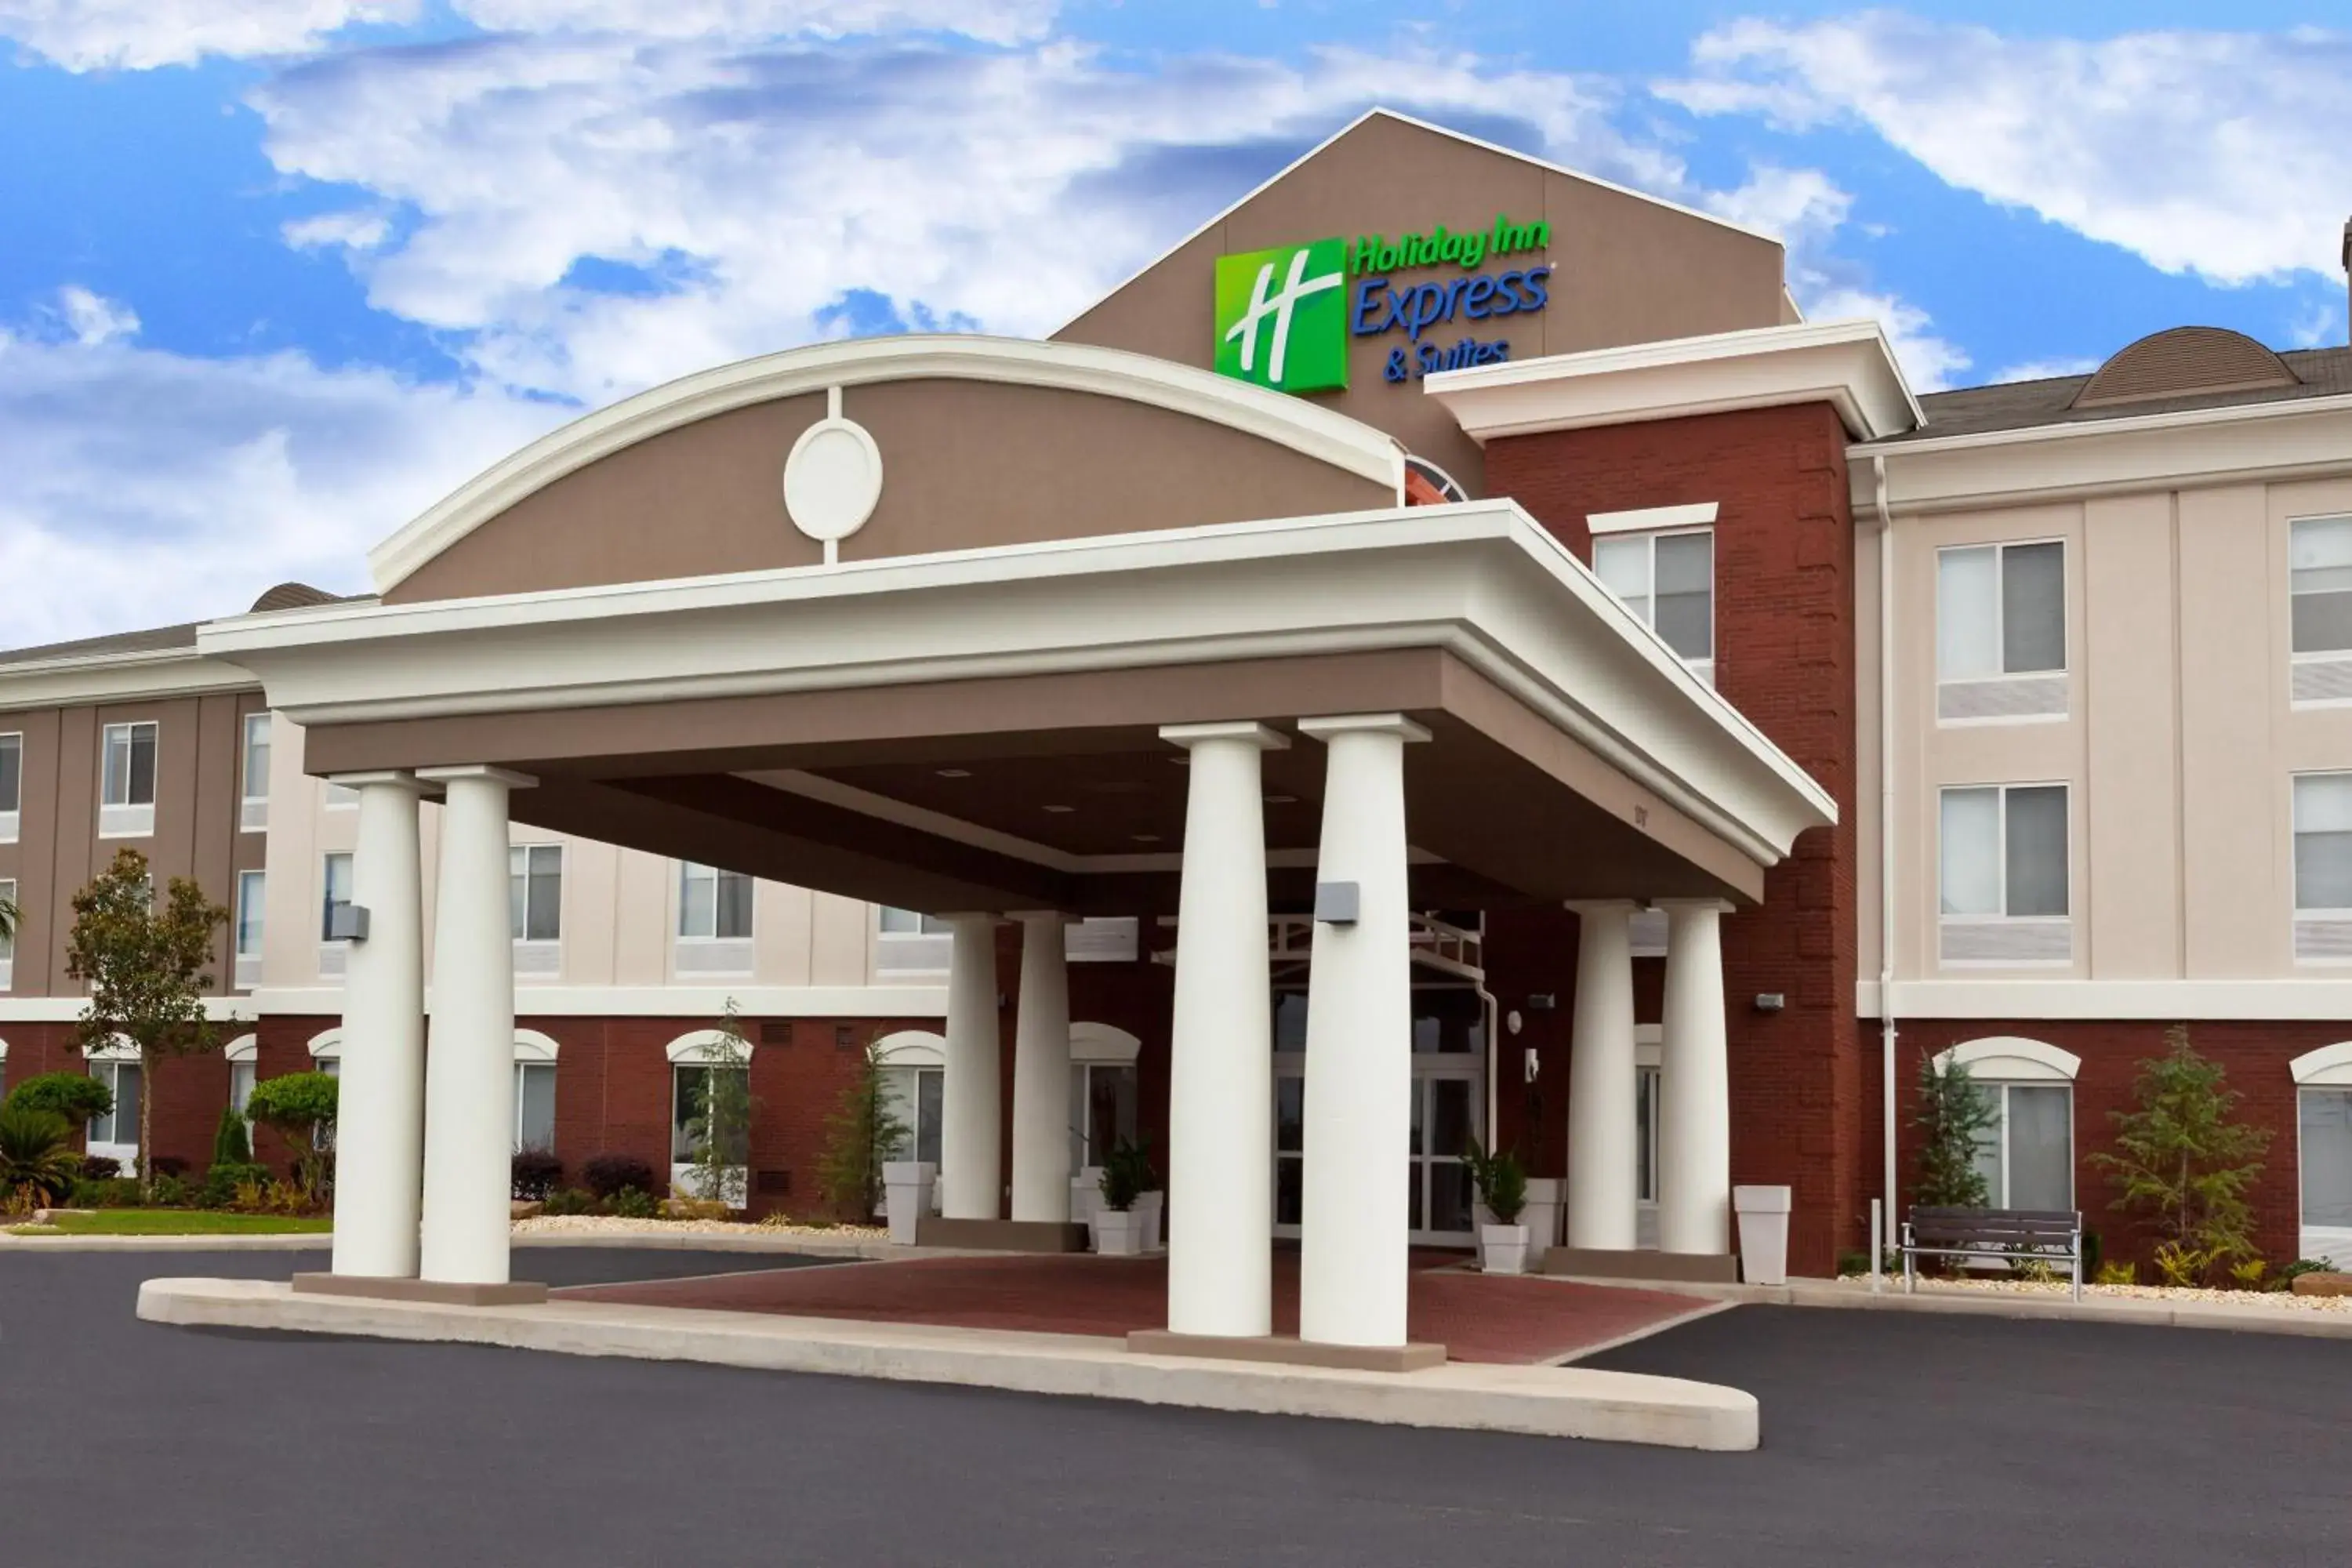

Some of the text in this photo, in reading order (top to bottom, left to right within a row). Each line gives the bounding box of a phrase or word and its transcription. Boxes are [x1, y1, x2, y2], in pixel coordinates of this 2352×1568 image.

[1352, 215, 1549, 274] Holiday Inn
[1351, 267, 1549, 341] Express
[1383, 337, 1509, 383] & Suites
